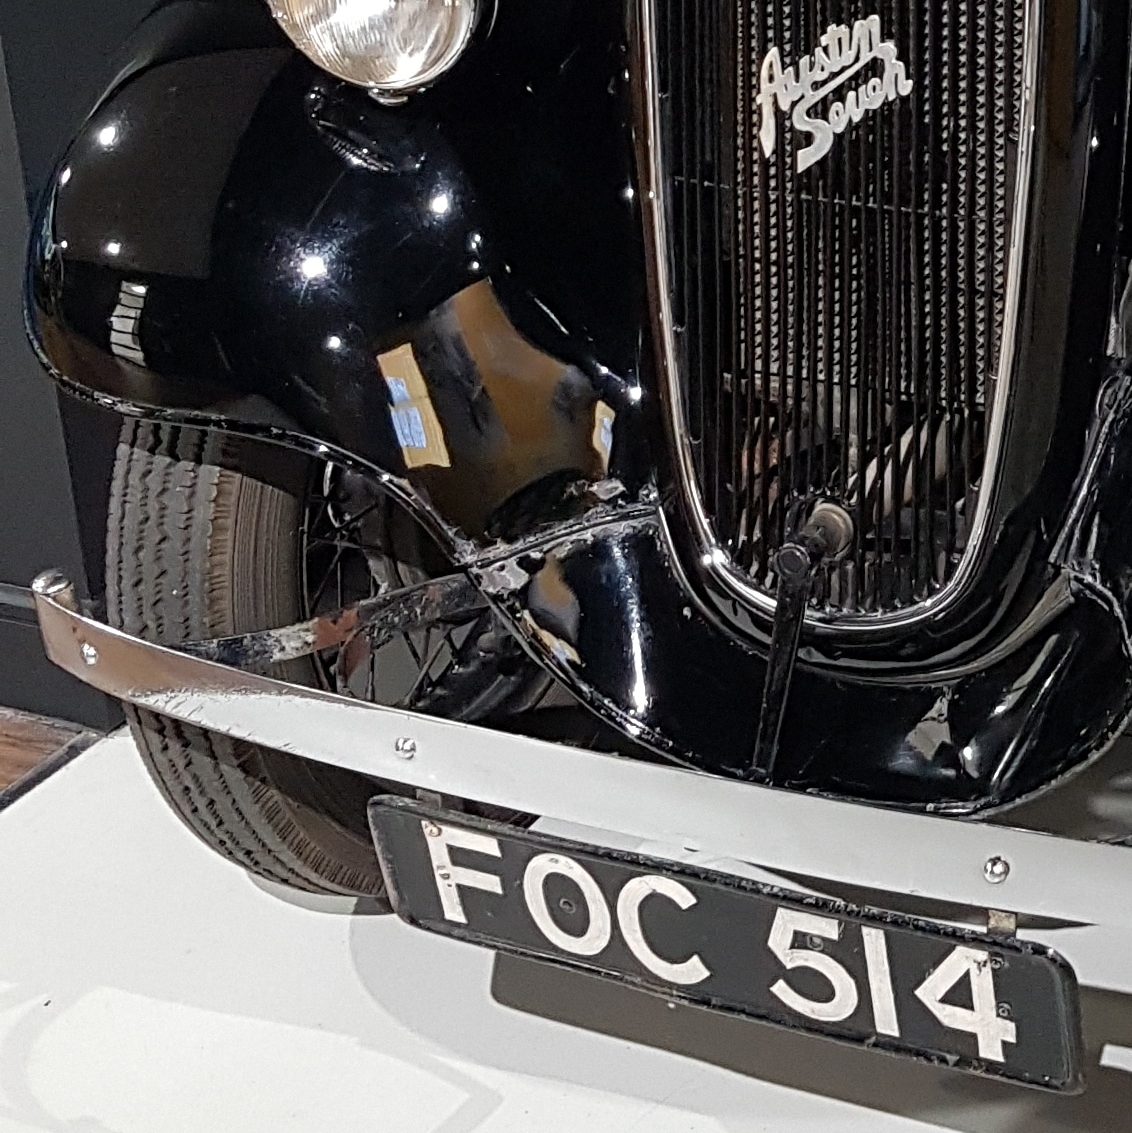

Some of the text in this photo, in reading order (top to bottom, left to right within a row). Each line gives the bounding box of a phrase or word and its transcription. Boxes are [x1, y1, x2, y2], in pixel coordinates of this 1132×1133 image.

[756, 15, 882, 159] Austin
[792, 41, 914, 174] Seven
[420, 819, 1018, 1063] FOC 514
